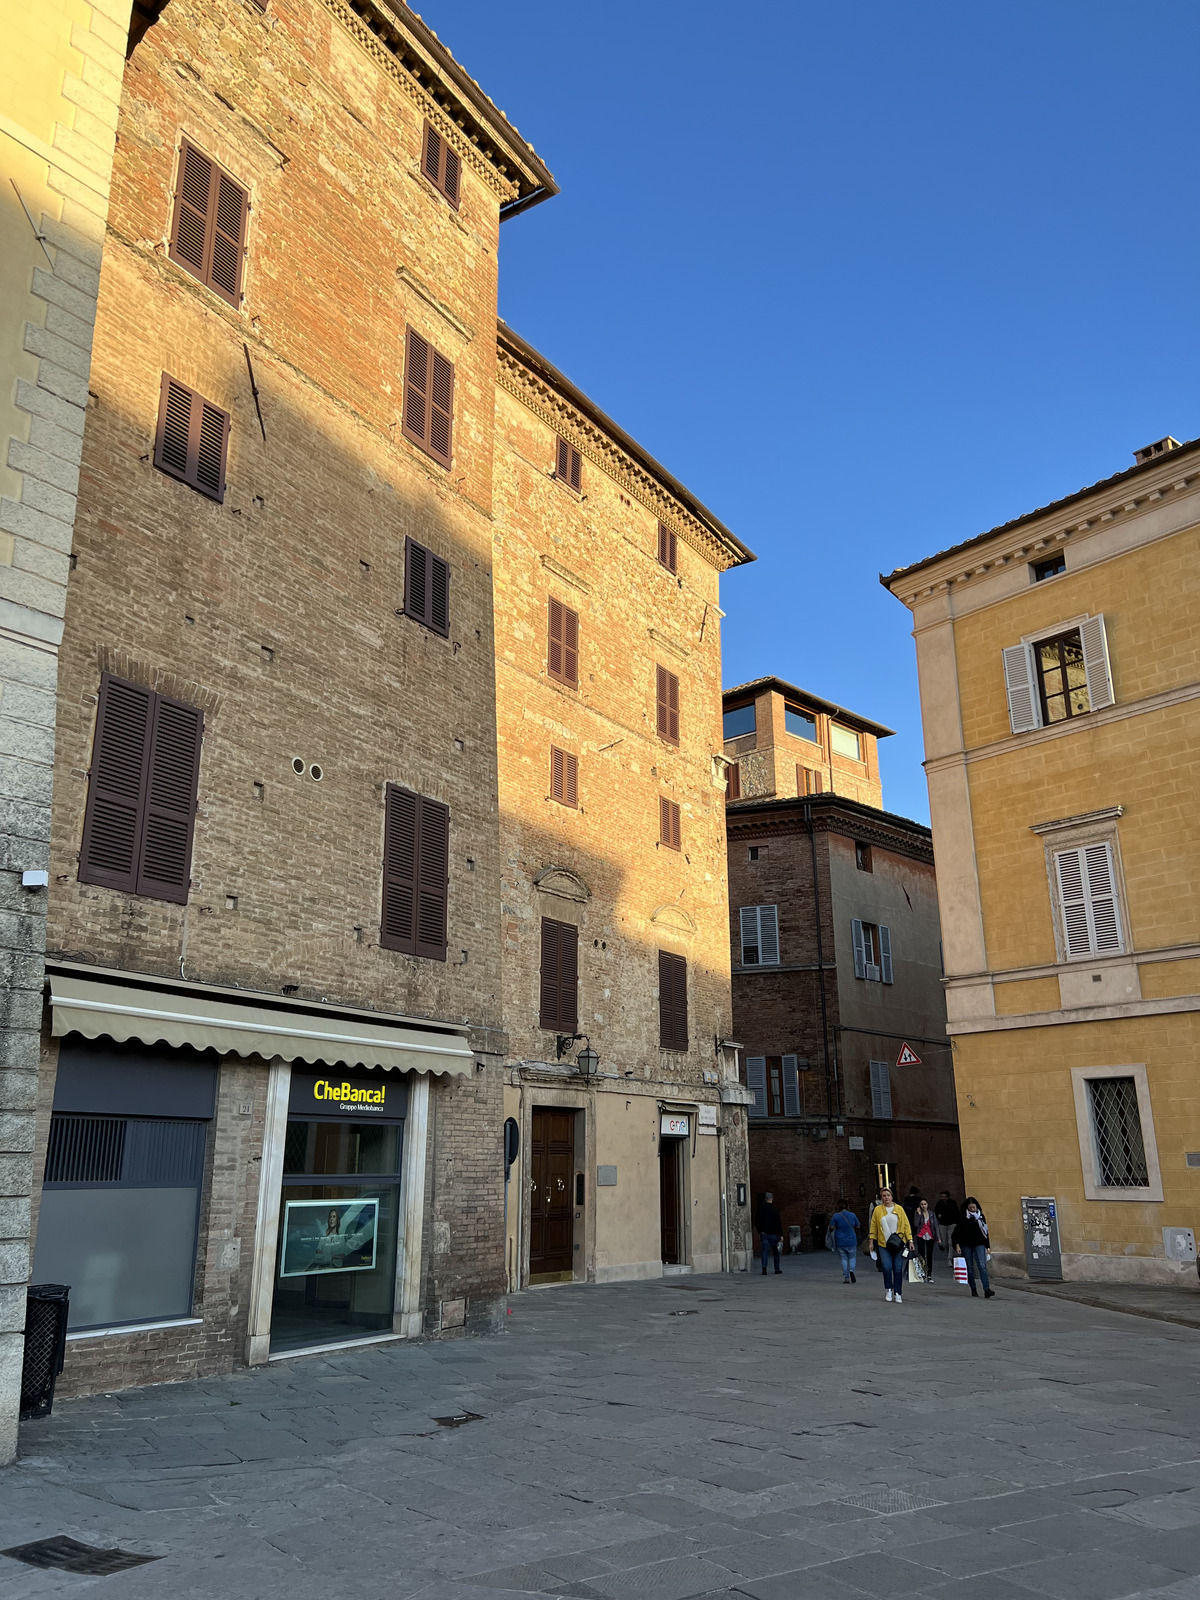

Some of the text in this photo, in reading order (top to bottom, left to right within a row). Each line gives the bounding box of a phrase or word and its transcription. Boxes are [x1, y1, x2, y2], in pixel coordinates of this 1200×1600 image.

[314, 1080, 386, 1103] CheBanca!
[243, 1105, 250, 1113] 21
[339, 1103, 357, 1111] Gruppo
[670, 1119, 687, 1131] enel
